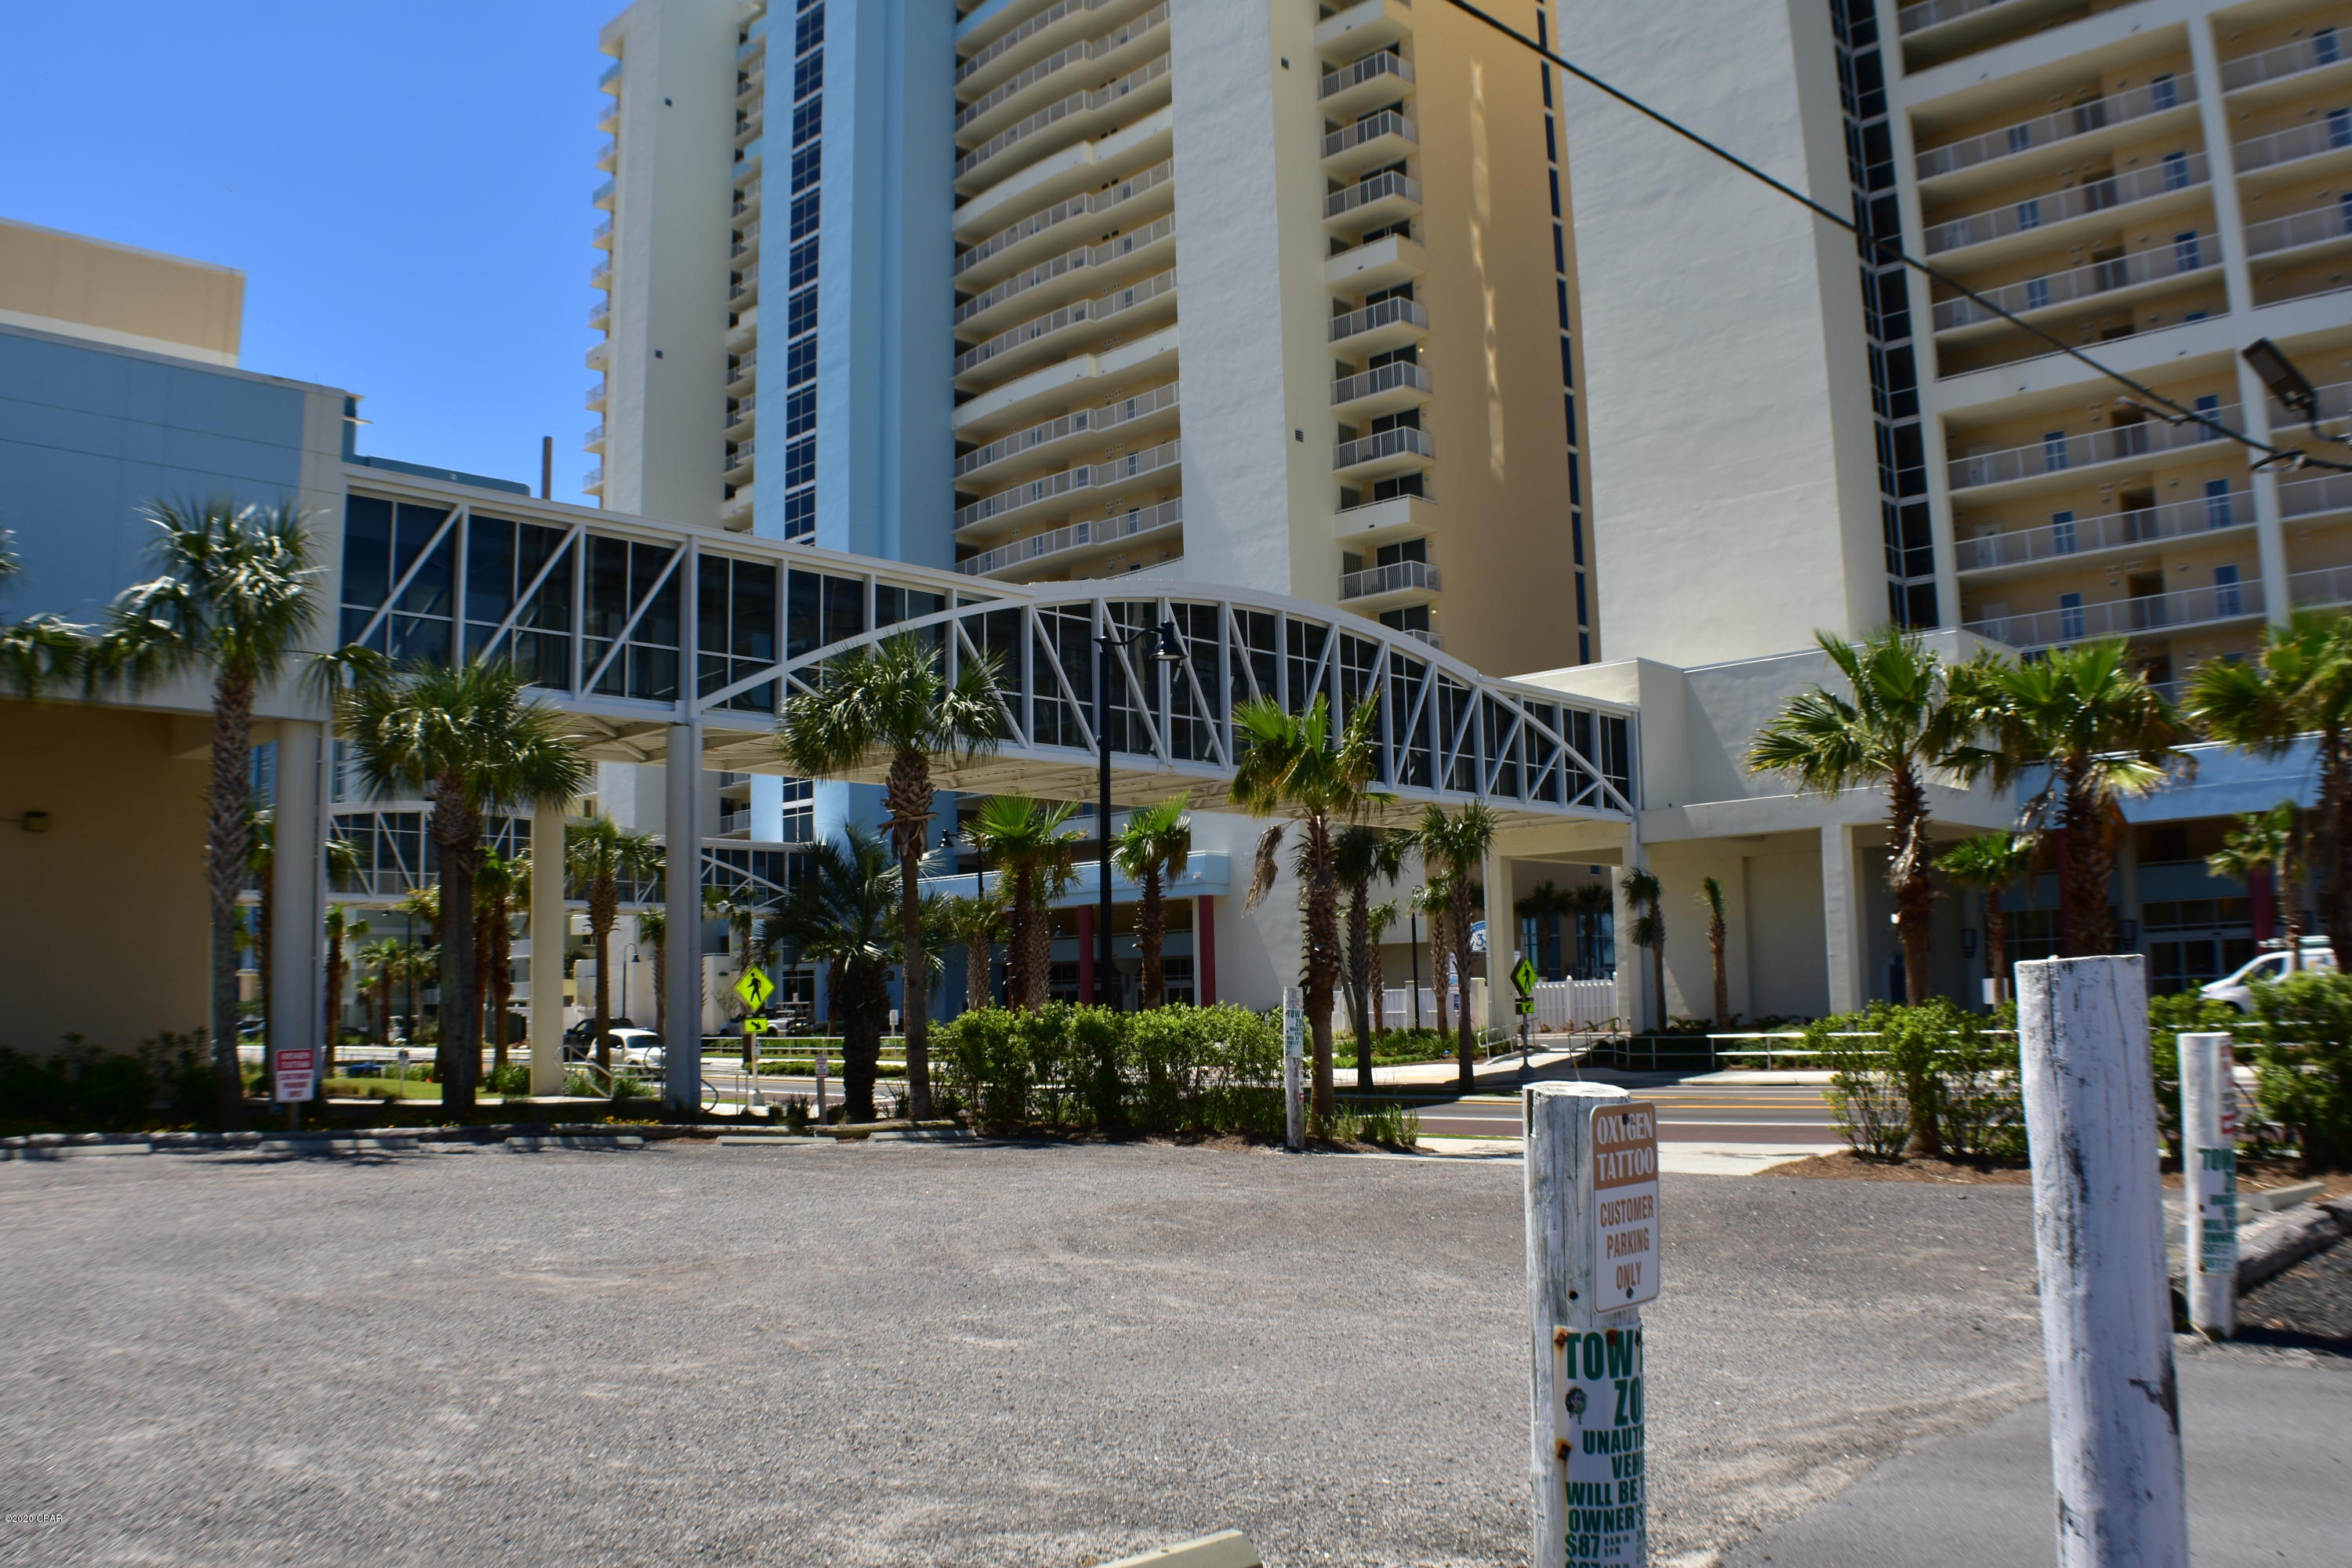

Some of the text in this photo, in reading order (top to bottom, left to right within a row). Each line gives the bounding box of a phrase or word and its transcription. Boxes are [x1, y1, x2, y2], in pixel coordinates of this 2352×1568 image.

[1597, 1112, 1653, 1145] OXYGEN
[1596, 1146, 1654, 1181] TATTOO
[1600, 1195, 1654, 1228] CUSTOMER
[1606, 1227, 1650, 1259] PARKING
[1616, 1261, 1642, 1290] ONLY
[1565, 1329, 1634, 1381] TOW
[1614, 1377, 1644, 1427] ZO
[1611, 1451, 1645, 1480] VEHI
[1565, 1482, 1613, 1507] WILL
[1618, 1479, 1637, 1504] BE
[1565, 1532, 1601, 1559] $87
